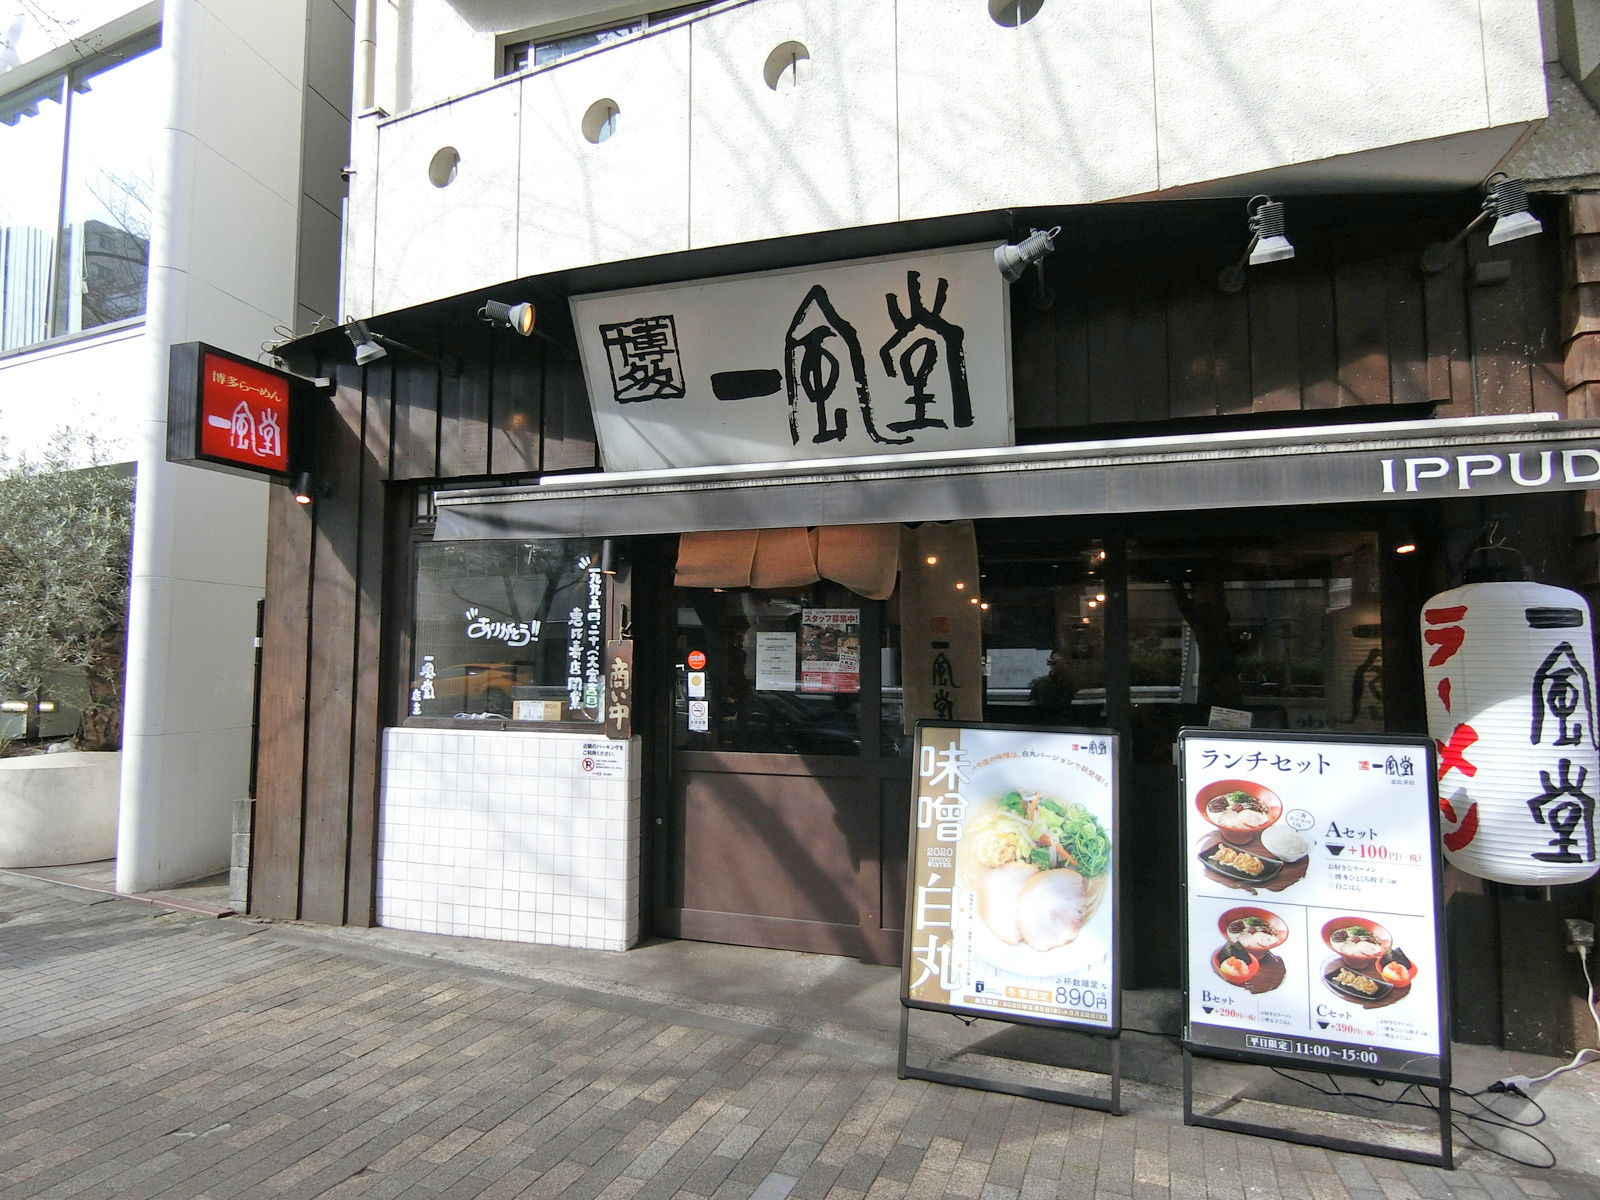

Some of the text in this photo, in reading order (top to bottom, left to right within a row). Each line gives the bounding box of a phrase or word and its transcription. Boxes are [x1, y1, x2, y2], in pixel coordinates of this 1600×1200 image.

[711, 271, 975, 446] 一風堂
[212, 370, 282, 402] 博多らーめん
[208, 400, 281, 457] 一風堂
[420, 655, 436, 699] 一風堂
[609, 657, 630, 731] 商い中
[1424, 606, 1479, 853] ラーメン
[1525, 607, 1600, 863] 一風堂
[1201, 750, 1331, 774] ランチセット
[1372, 755, 1414, 776] 一風堂
[917, 741, 970, 841] 味噌
[1325, 821, 1378, 840] Aセット
[927, 847, 953, 857] 2020
[910, 872, 961, 990] 白丸
[1007, 986, 1050, 1001] 冬季限定
[1064, 977, 1099, 989] 杯数限定
[1055, 986, 1107, 1009] 890円
[1202, 990, 1234, 1005] Bセット
[1316, 1004, 1352, 1020] Cセット
[1250, 1036, 1288, 1050] 平日限定
